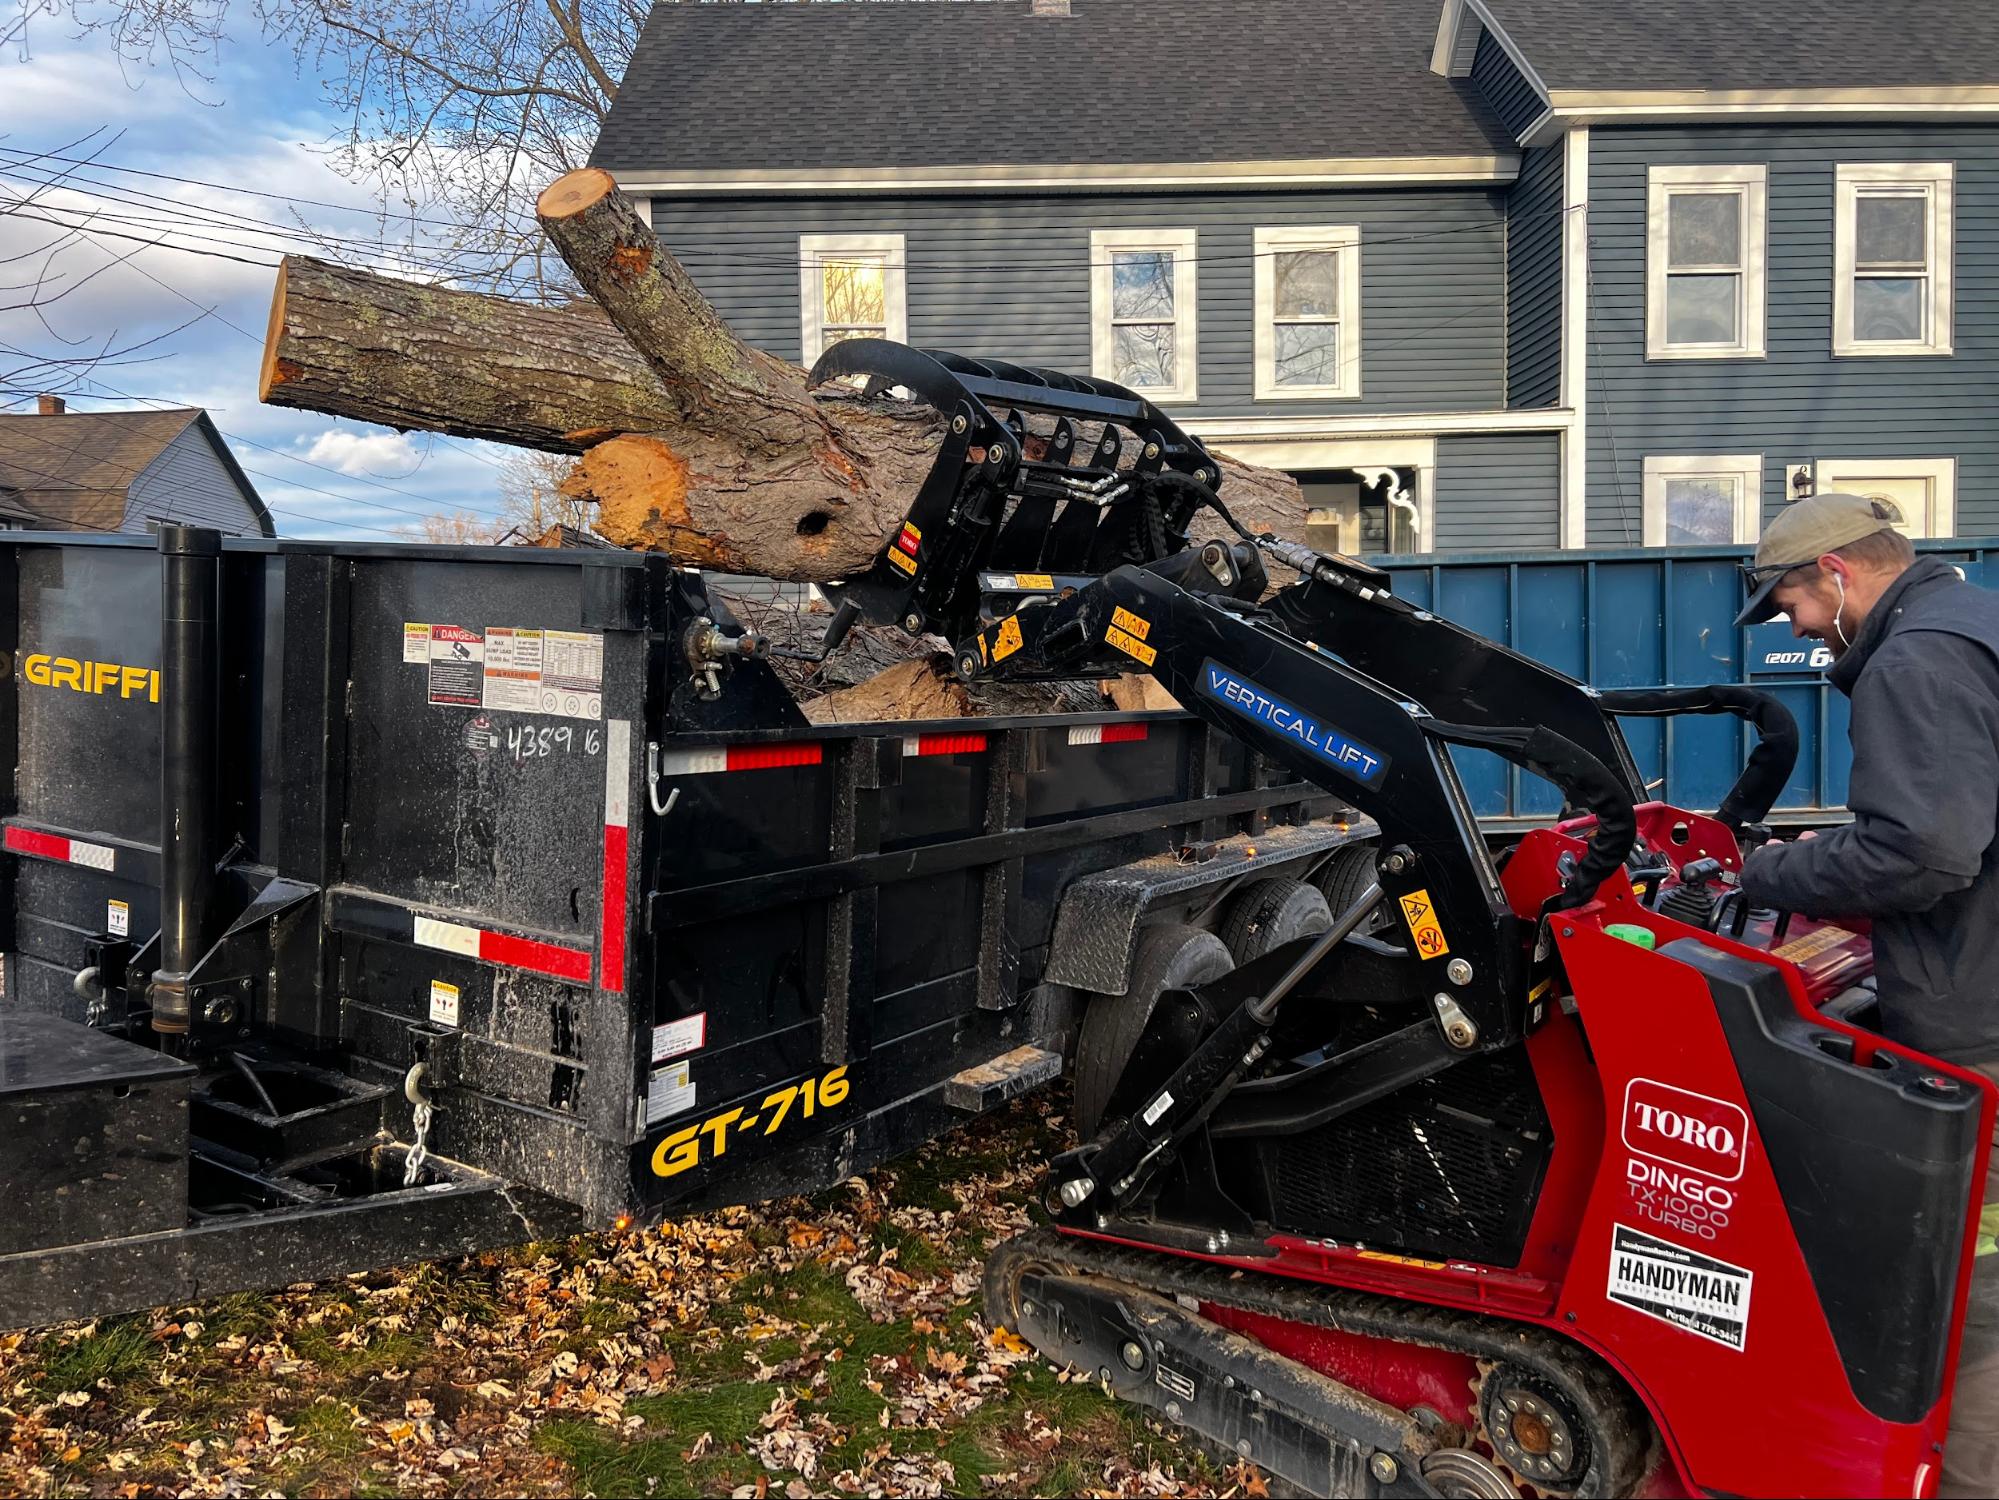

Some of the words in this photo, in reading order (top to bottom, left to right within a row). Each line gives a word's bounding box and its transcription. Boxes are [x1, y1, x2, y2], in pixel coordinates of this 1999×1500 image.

[902, 535, 917, 550] TORO
[441, 629, 476, 641] DANGER
[1765, 652, 1805, 664] (207)
[1809, 647, 1835, 667] 6
[1211, 670, 1319, 747] VERTICAL
[1323, 735, 1378, 774] LIFT
[508, 725, 572, 761] 4389
[651, 1065, 850, 1178] GT-716
[1634, 1101, 1735, 1155] TORO
[1626, 1158, 1733, 1210] DINGO
[1635, 1201, 1717, 1241] TURBO
[1621, 1239, 1691, 1262] HandymanRental.com
[1616, 1282, 1684, 1304] EQUIPMENT
[1692, 1300, 1738, 1315] RENTAL
[1618, 1256, 1741, 1307] HANDYMAN
